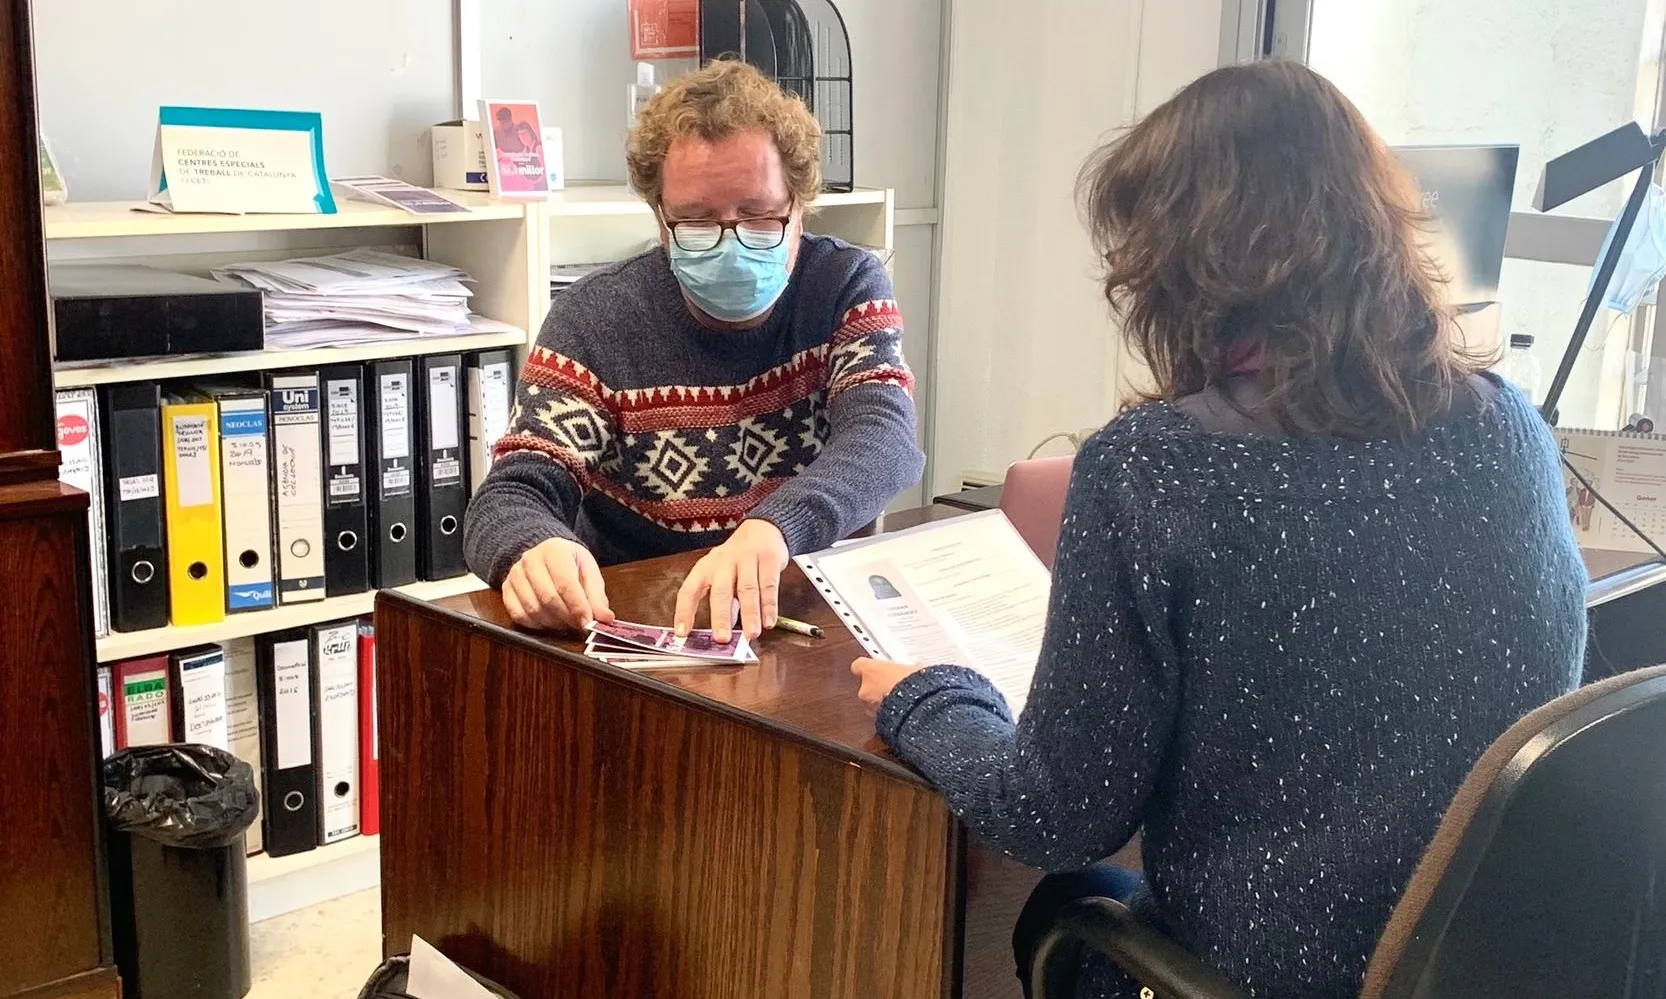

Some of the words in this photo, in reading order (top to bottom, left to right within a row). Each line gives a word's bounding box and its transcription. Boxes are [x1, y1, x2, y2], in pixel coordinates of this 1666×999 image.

[177, 148, 227, 157] FEDERACIÓ
[229, 150, 241, 158] DE
[178, 159, 218, 167] CENTRES
[220, 160, 265, 169] ESPECIALS
[179, 168, 191, 176] DE
[194, 168, 231, 177] TREBALL
[233, 170, 244, 178] DE
[247, 170, 297, 179] CATALUNYA
[518, 165, 545, 176] millor
[282, 390, 310, 404] Uni
[282, 403, 310, 412] system
[225, 421, 263, 429] NEOCLAS
[126, 681, 164, 696] ELBA
[127, 691, 164, 703] RADO
